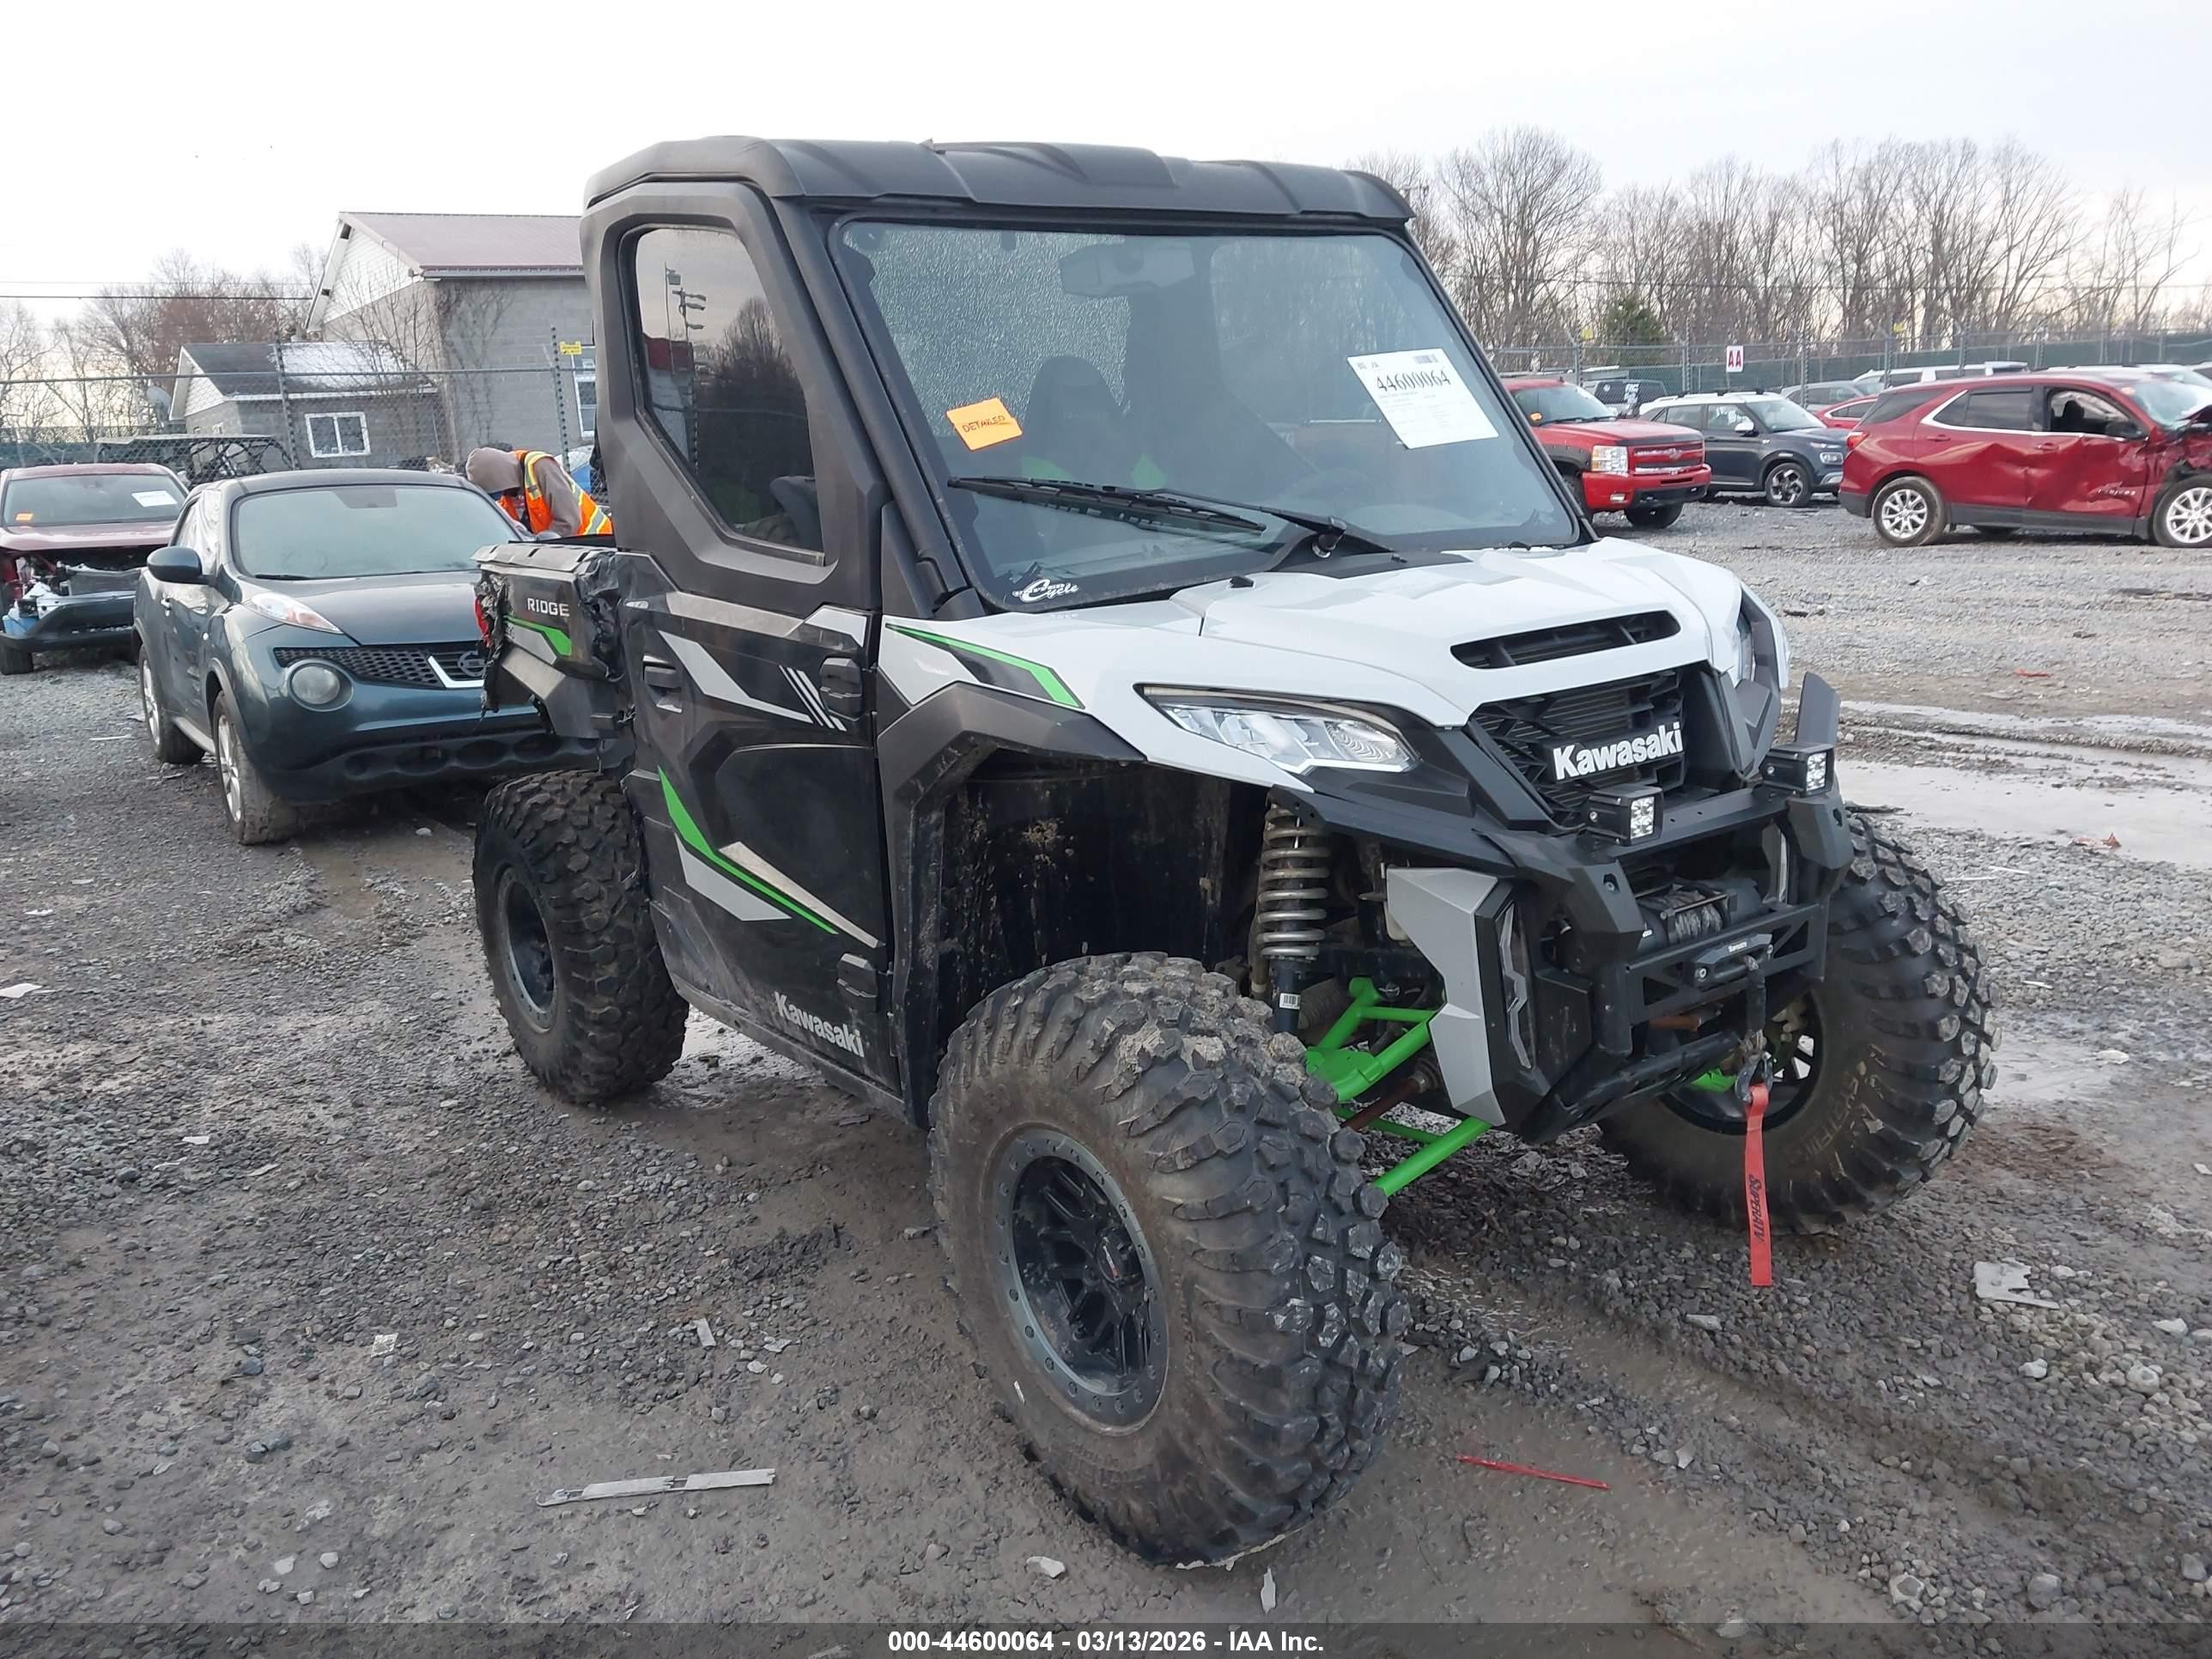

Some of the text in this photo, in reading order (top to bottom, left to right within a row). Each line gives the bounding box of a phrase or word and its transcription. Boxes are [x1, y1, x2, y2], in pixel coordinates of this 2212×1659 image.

[1728, 349, 1741, 368] AA
[1376, 369, 1452, 392] 44600064
[962, 415, 1006, 433] DETAILED
[527, 597, 570, 617] RIDGE
[1553, 721, 1684, 781] Kawasaki
[774, 990, 865, 1058] Kawasaki
